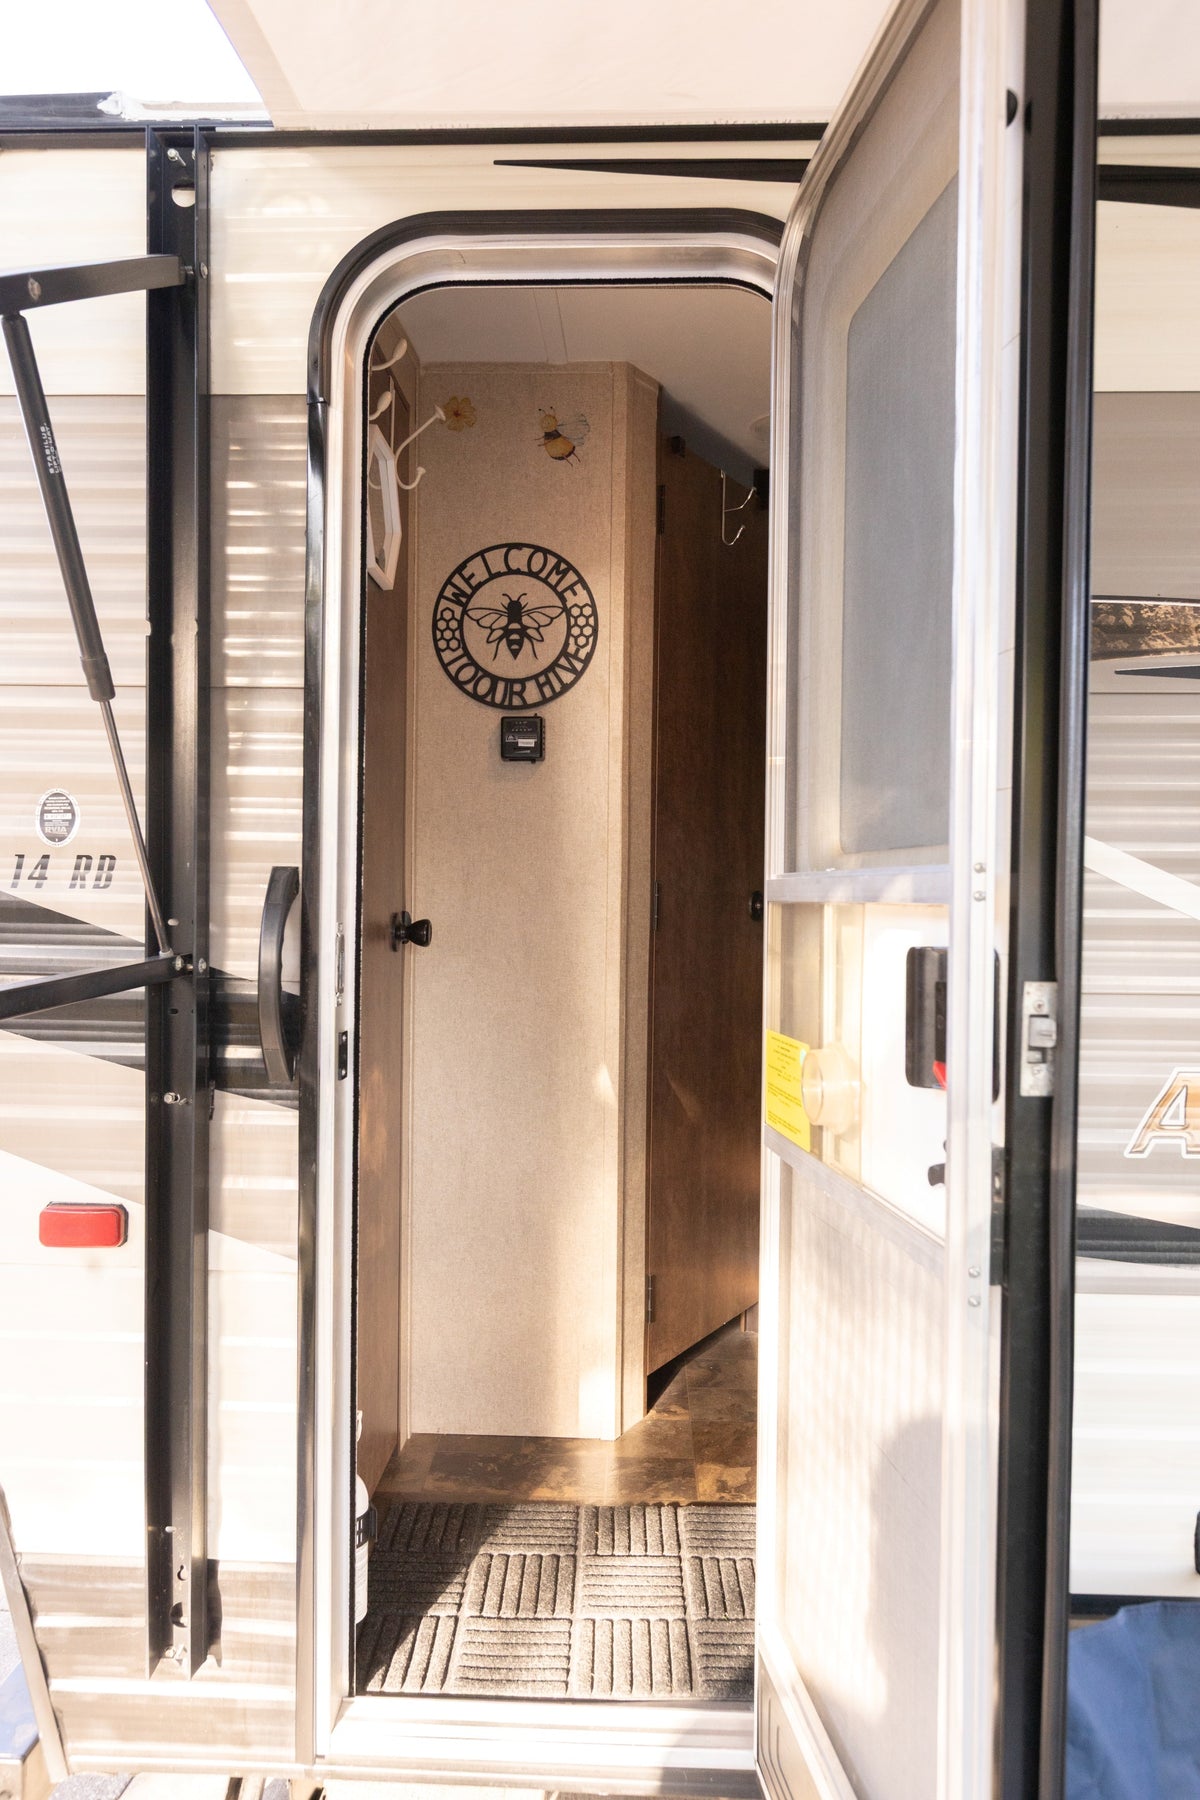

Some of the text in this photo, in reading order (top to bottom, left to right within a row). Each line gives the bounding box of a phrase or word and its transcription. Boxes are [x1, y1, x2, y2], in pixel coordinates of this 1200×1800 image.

[40, 425, 55, 473] STABILUS
[439, 546, 587, 608] WELCOME
[445, 642, 591, 706] TO OUR HIVE
[11, 854, 117, 889] 14 RB
